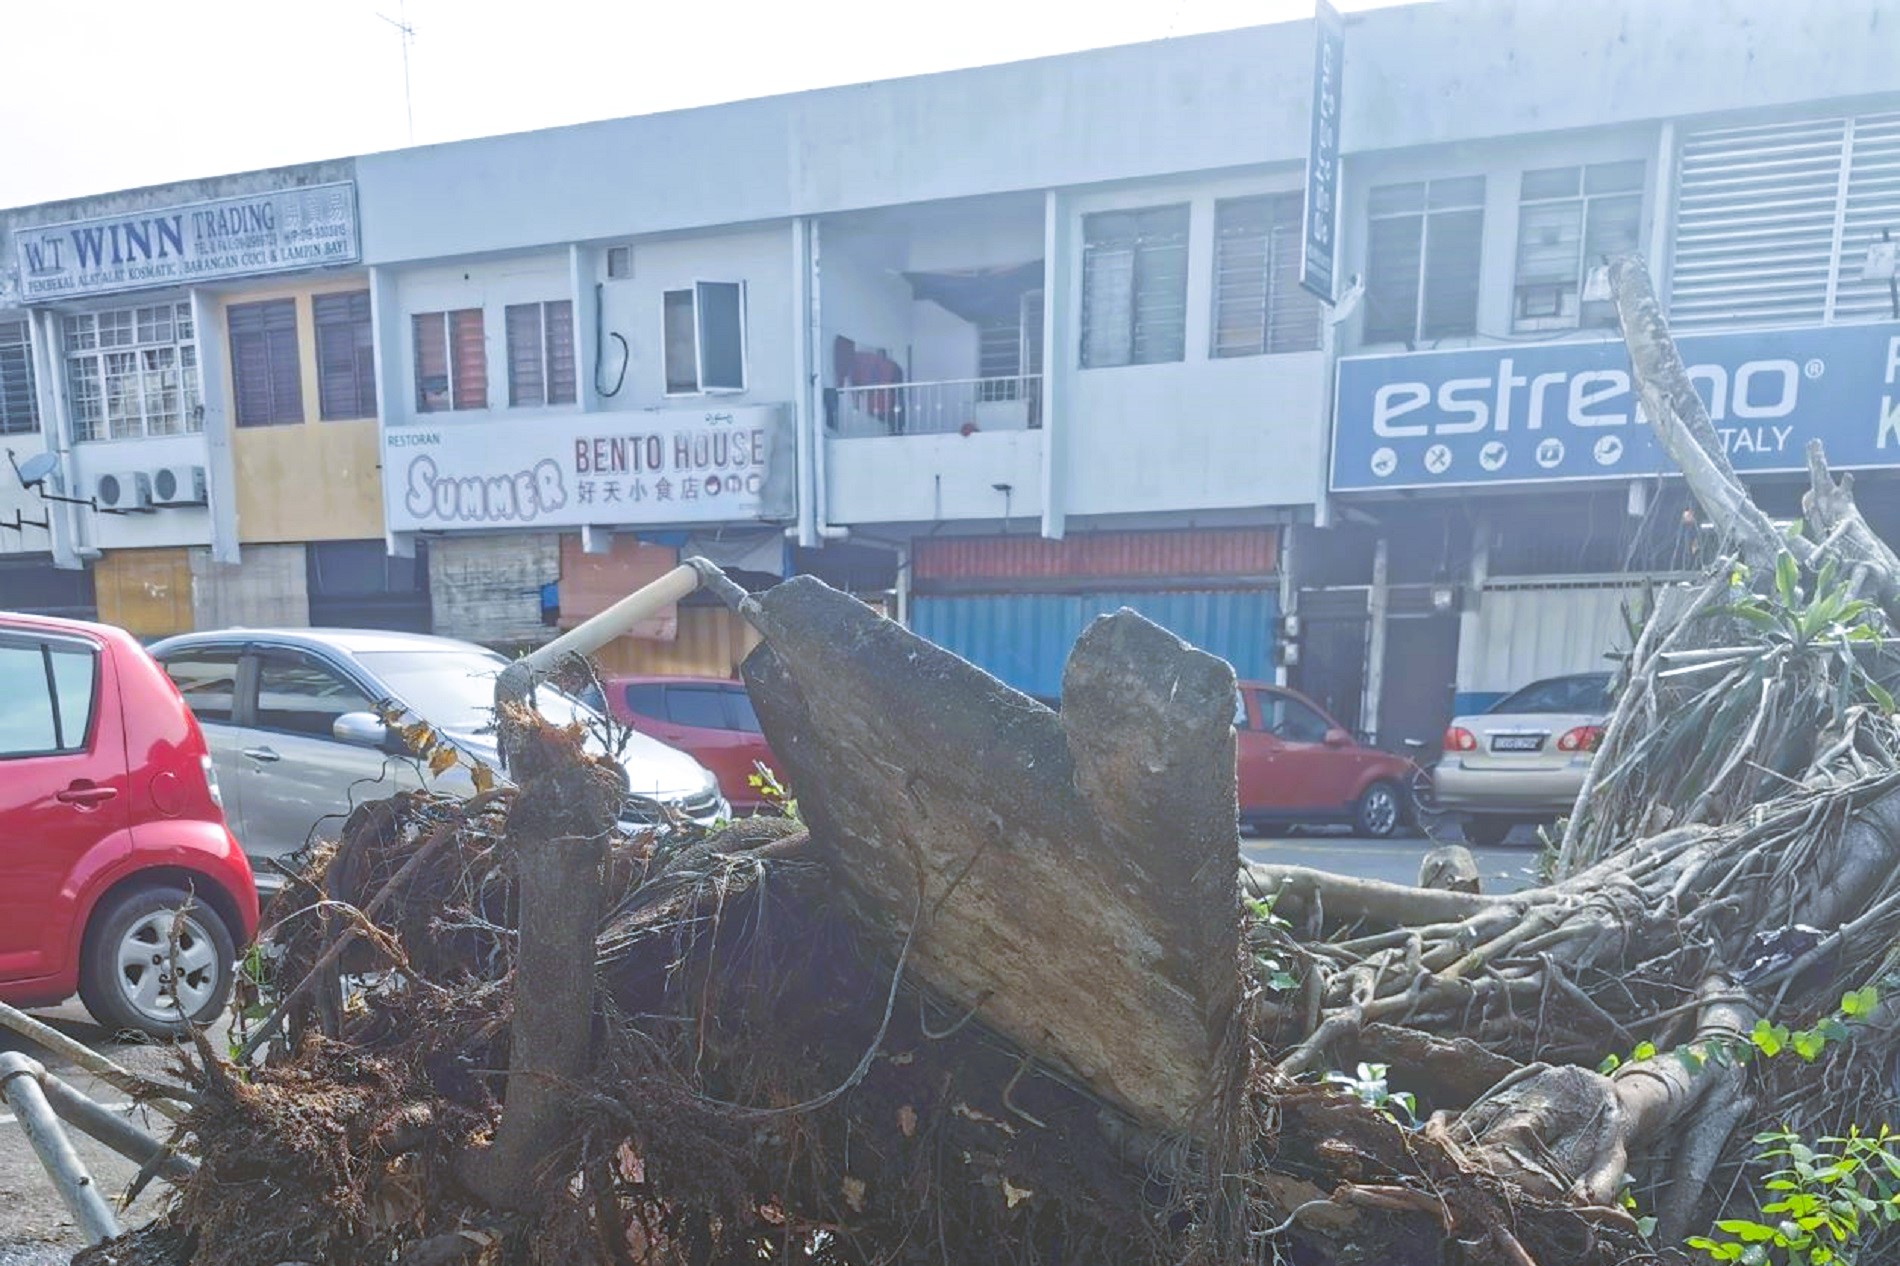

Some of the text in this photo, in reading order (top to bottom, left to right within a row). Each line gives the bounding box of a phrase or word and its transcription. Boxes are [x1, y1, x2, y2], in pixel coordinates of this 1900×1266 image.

[71, 214, 184, 269] WINN
[191, 202, 275, 239] TRADING
[387, 433, 441, 448] RESTORAN
[575, 428, 765, 475] BENTO HOUSE
[1717, 425, 1793, 453] TALY
[577, 475, 699, 504] 好天小食店
